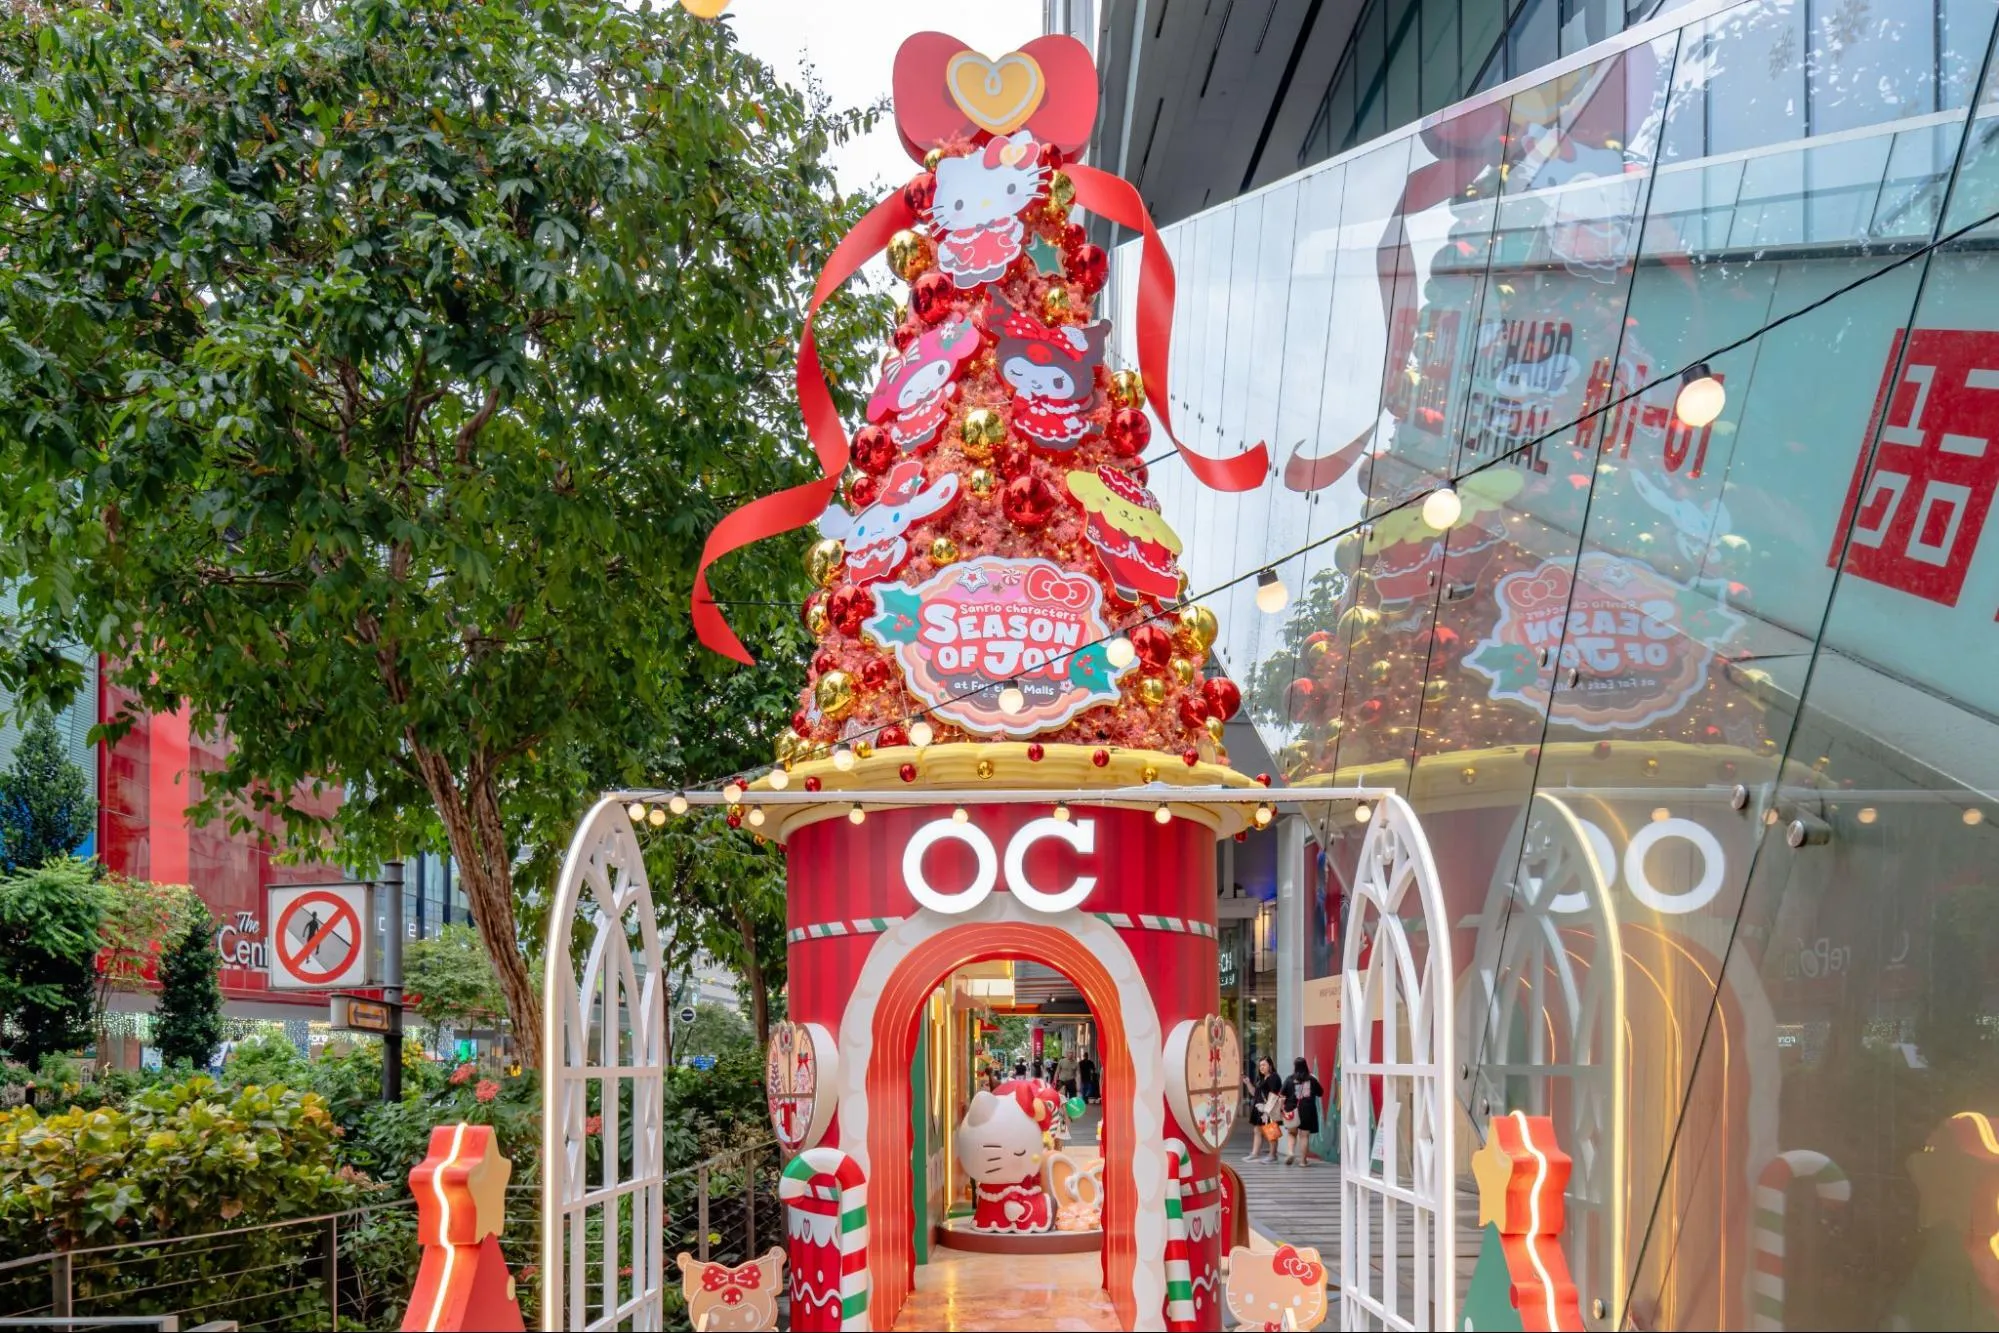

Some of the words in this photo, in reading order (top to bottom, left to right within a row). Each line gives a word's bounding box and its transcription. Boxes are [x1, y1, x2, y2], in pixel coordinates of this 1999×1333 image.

[923, 603, 1081, 646] SEASON
[960, 603, 1002, 614] Sanrio
[1006, 603, 1077, 622] characters
[937, 646, 978, 669] OF
[984, 639, 1071, 675] JOY
[953, 681, 969, 690] at
[1023, 684, 1055, 696] Malls
[902, 817, 1098, 914] OC
[235, 911, 260, 934] The
